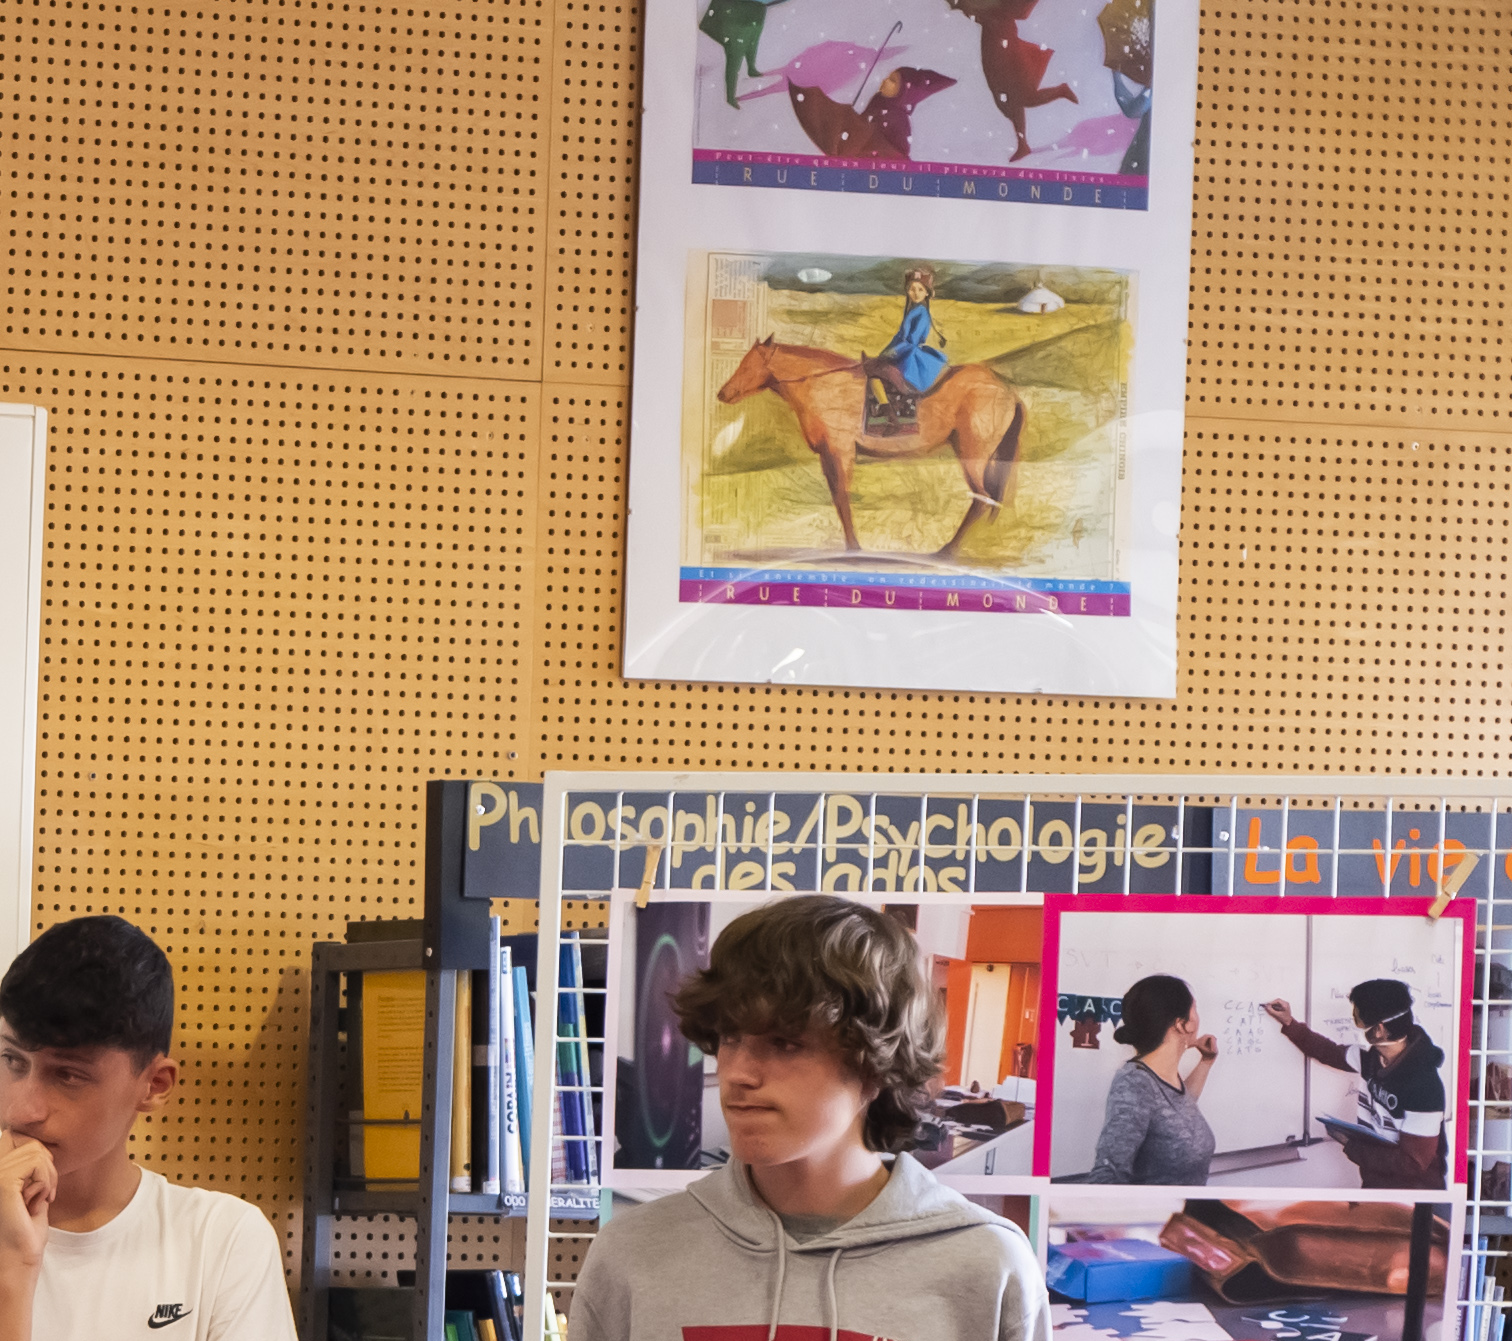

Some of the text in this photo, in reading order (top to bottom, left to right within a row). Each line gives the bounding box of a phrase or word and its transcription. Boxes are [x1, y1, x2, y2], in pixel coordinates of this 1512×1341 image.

[715, 151, 800, 165] Peut-être
[812, 158, 859, 169] qu'un
[872, 160, 907, 171] jour
[919, 163, 931, 172] il
[944, 165, 1007, 178] pleuvra
[1019, 169, 1044, 180] des
[743, 166, 1103, 204] RUE DU MONDE
[868, 576, 886, 584] on
[1045, 582, 1096, 592] monde
[727, 585, 1087, 612] RUE DU MONDE
[1245, 817, 1470, 888] La vie
[154, 1303, 184, 1319] NIKE
